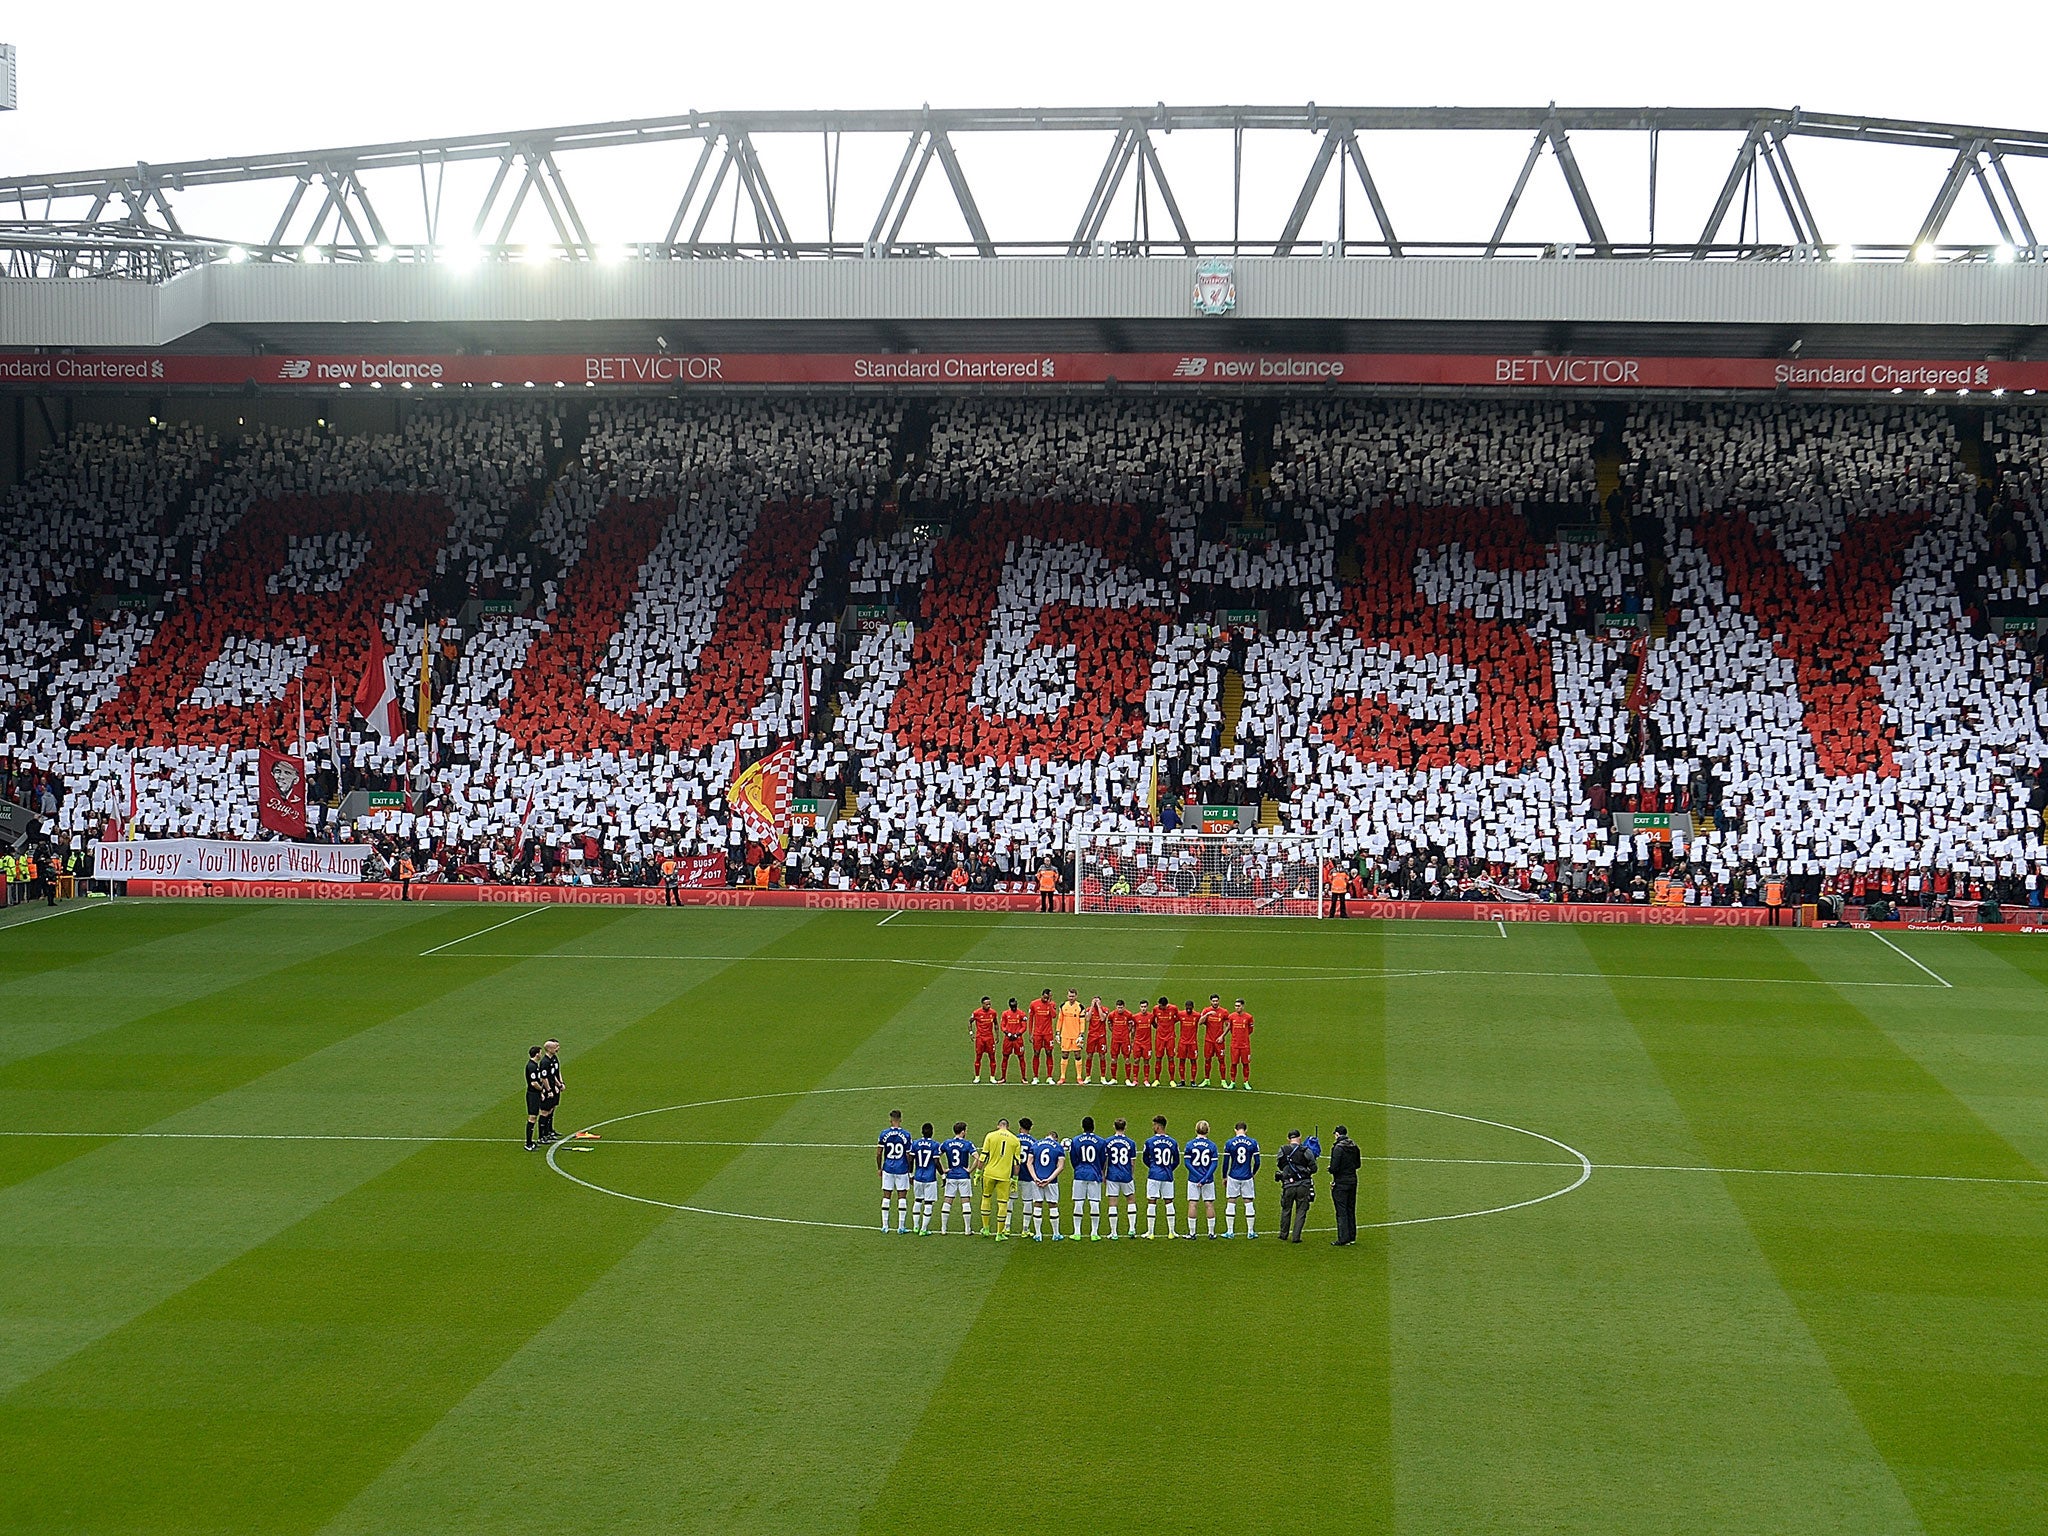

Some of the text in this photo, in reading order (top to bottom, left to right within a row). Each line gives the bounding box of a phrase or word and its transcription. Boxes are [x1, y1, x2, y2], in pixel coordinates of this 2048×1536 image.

[0, 360, 147, 377] ndard Chartered
[317, 361, 443, 378] new balance
[586, 358, 722, 379] BETVICTOR
[854, 360, 1037, 377] Standard Chartered
[1214, 358, 1344, 376] new balance
[1496, 359, 1640, 383] BETVICTOR
[1775, 364, 1970, 384] Standard Chartered
[266, 797, 300, 819] Bugsy
[791, 816, 810, 827] 106
[1210, 823, 1229, 833] 105
[100, 847, 133, 872] R.I.P.
[140, 848, 182, 875] Bugsy
[198, 847, 236, 872] You'll
[241, 848, 282, 873] Never
[287, 847, 322, 873] Walk
[693, 857, 718, 868] BUGSY
[702, 869, 722, 880] 2017
[151, 881, 225, 898] Ronnie
[231, 882, 299, 899] Moran
[307, 884, 356, 900] 1934
[479, 886, 552, 903] Ronnie
[559, 887, 626, 904] Moran
[705, 891, 755, 907] 2017
[805, 892, 880, 909] Ronnie
[886, 893, 955, 911] Moran
[962, 895, 1011, 911] 1934
[1371, 902, 1422, 919] 2017
[1473, 904, 1551, 922] Ronnie
[1558, 905, 1629, 924] Moran
[1637, 907, 1688, 925] 1934
[1713, 908, 1766, 926] 2017
[886, 1142, 904, 1160] 29
[1000, 1140, 1006, 1157] 1
[1020, 1145, 1029, 1163] 5
[1040, 1148, 1050, 1167] 6
[1080, 1145, 1096, 1163] 10
[1110, 1146, 1129, 1166] 38
[1153, 1147, 1171, 1166] 30
[1191, 1148, 1210, 1167] 26
[1236, 1146, 1247, 1164] 8
[918, 1149, 932, 1168] 17
[951, 1149, 961, 1167] 3
